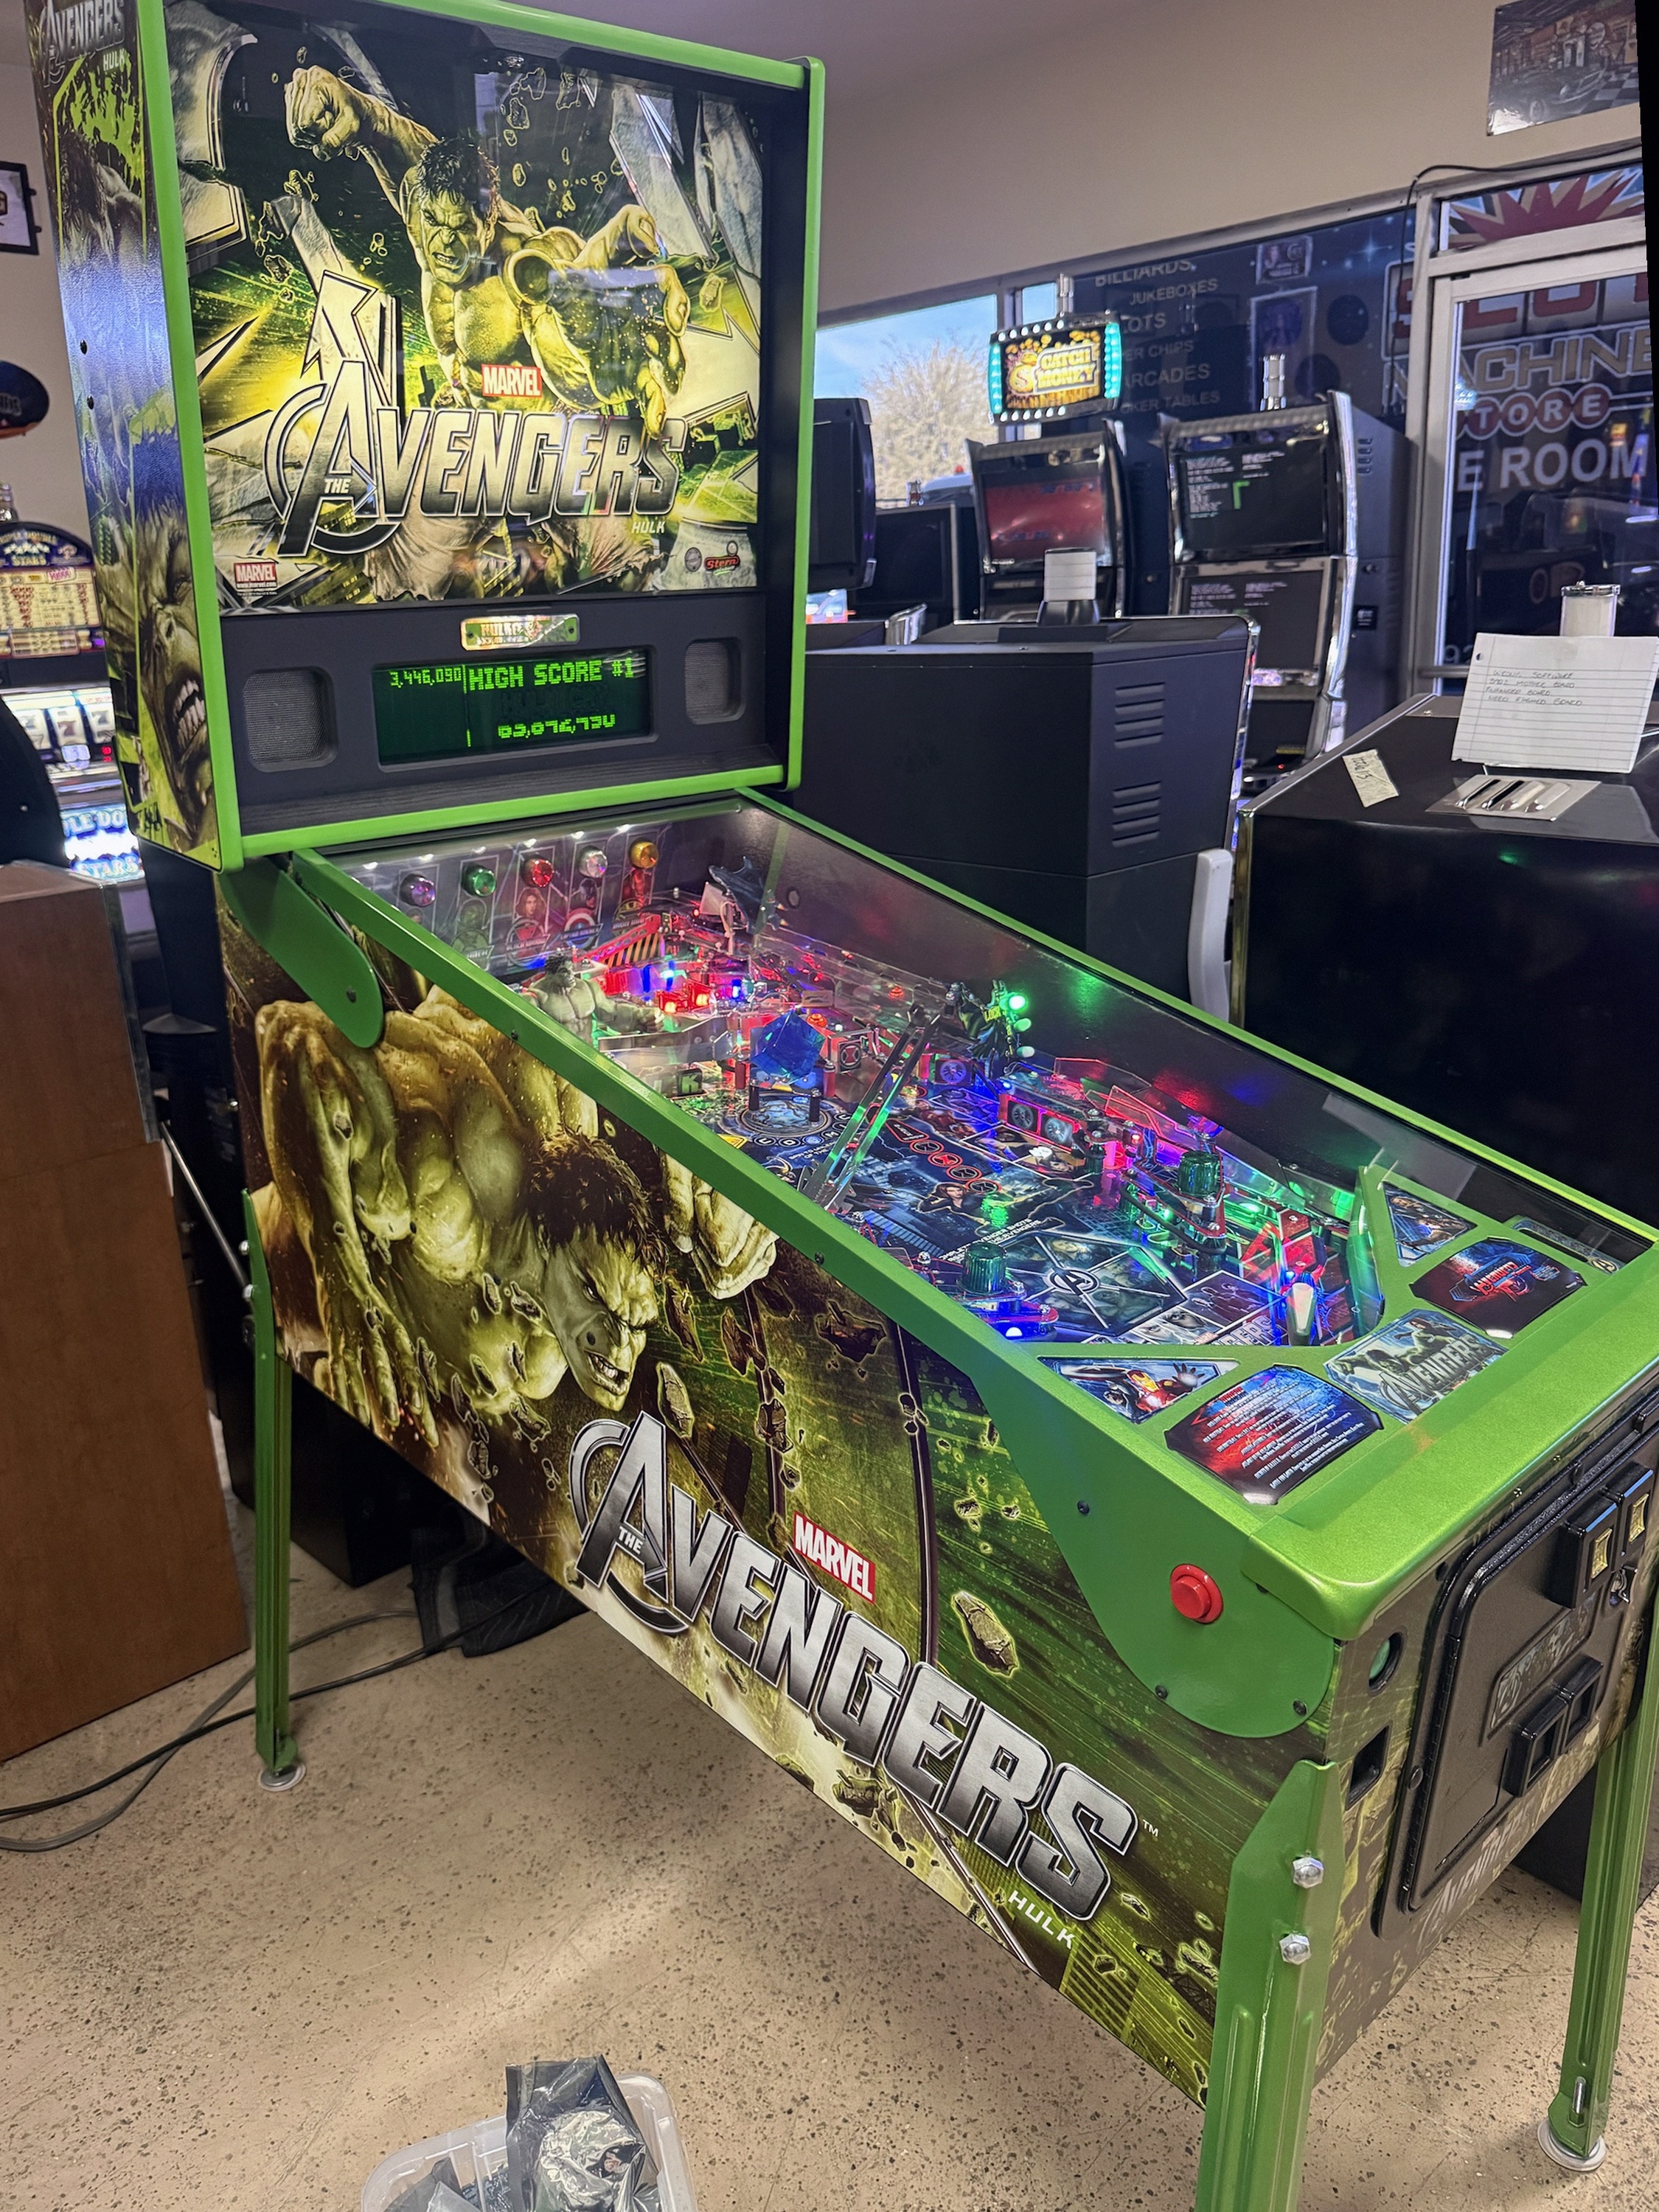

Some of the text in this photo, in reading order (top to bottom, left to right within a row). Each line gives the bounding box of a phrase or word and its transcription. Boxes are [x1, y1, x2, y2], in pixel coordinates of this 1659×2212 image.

[103, 49, 125, 71] HULK
[1095, 260, 1192, 287] BILLIARDS
[1130, 279, 1219, 305] JUKEBOXES
[1127, 313, 1166, 332] OTS
[1148, 340, 1194, 358] CHIPS
[484, 369, 540, 396] MARVEL
[1036, 363, 1096, 389] MONEY
[1120, 391, 1220, 414] OKER TABLES
[1477, 394, 1603, 429] TORE
[265, 361, 687, 557] AVENGERS
[1500, 437, 1648, 488] ROOM
[324, 477, 350, 495] THE
[631, 521, 666, 534] HULK
[235, 563, 276, 582] MARVEL
[706, 557, 737, 571] Stern
[390, 666, 462, 689] 3,446,090
[468, 665, 524, 691] HIGH
[534, 659, 602, 686] SCORE
[1553, 698, 1583, 706] BOARD
[1380, 1333, 1495, 1415] AVENGERS
[618, 1524, 643, 1555] THE
[793, 1514, 875, 1602] MARVEL
[569, 1411, 1138, 1921] AVENGERS
[1142, 1819, 1159, 1837] TM
[1008, 1889, 1075, 1949] HULK
